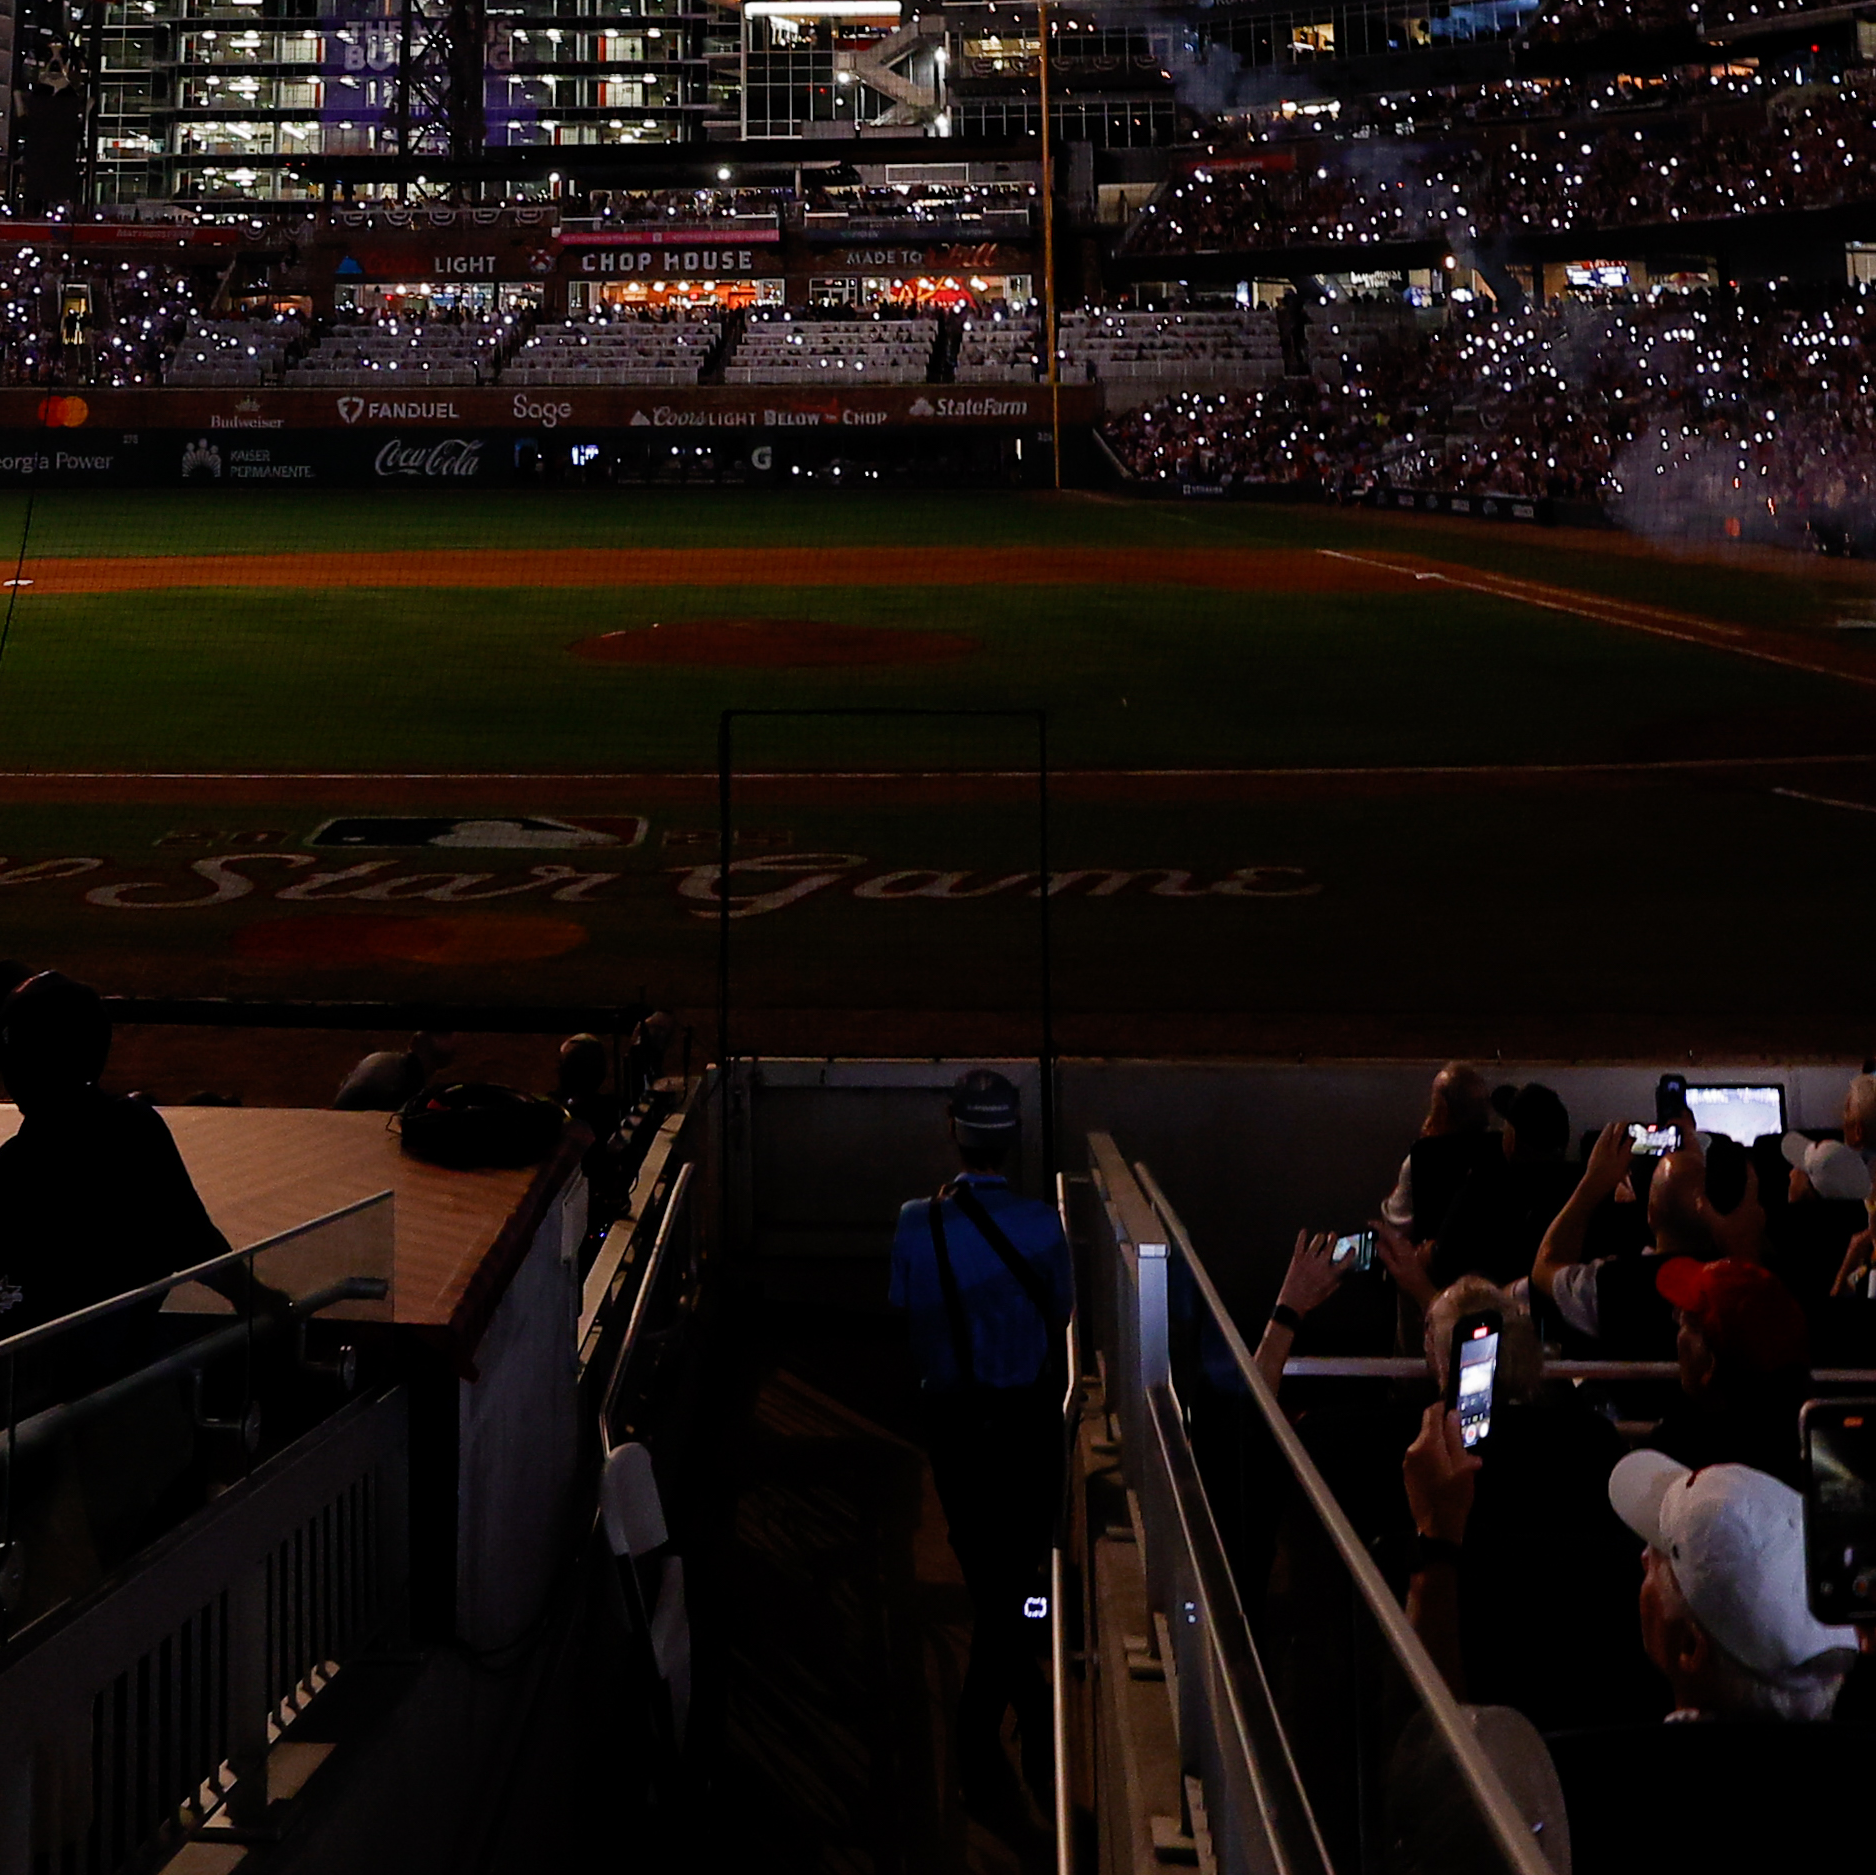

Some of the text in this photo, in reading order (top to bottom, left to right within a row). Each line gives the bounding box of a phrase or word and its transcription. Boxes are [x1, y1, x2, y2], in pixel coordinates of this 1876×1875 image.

[434, 255, 497, 273] LIGHT
[582, 250, 753, 272] CHOP HOUSE
[846, 250, 895, 265] MADE
[901, 251, 923, 265] TO
[368, 402, 460, 419] FANDUEL
[512, 394, 573, 428] Sage
[652, 405, 707, 426] Coors
[709, 411, 757, 426] LIGHT
[764, 409, 822, 426] BELOW
[842, 408, 888, 425] CHOP
[210, 414, 285, 430] Budweiser
[55, 451, 115, 470] Power
[230, 449, 271, 463] KAISER
[83, 851, 625, 911] Star
[661, 852, 1325, 919] Game
